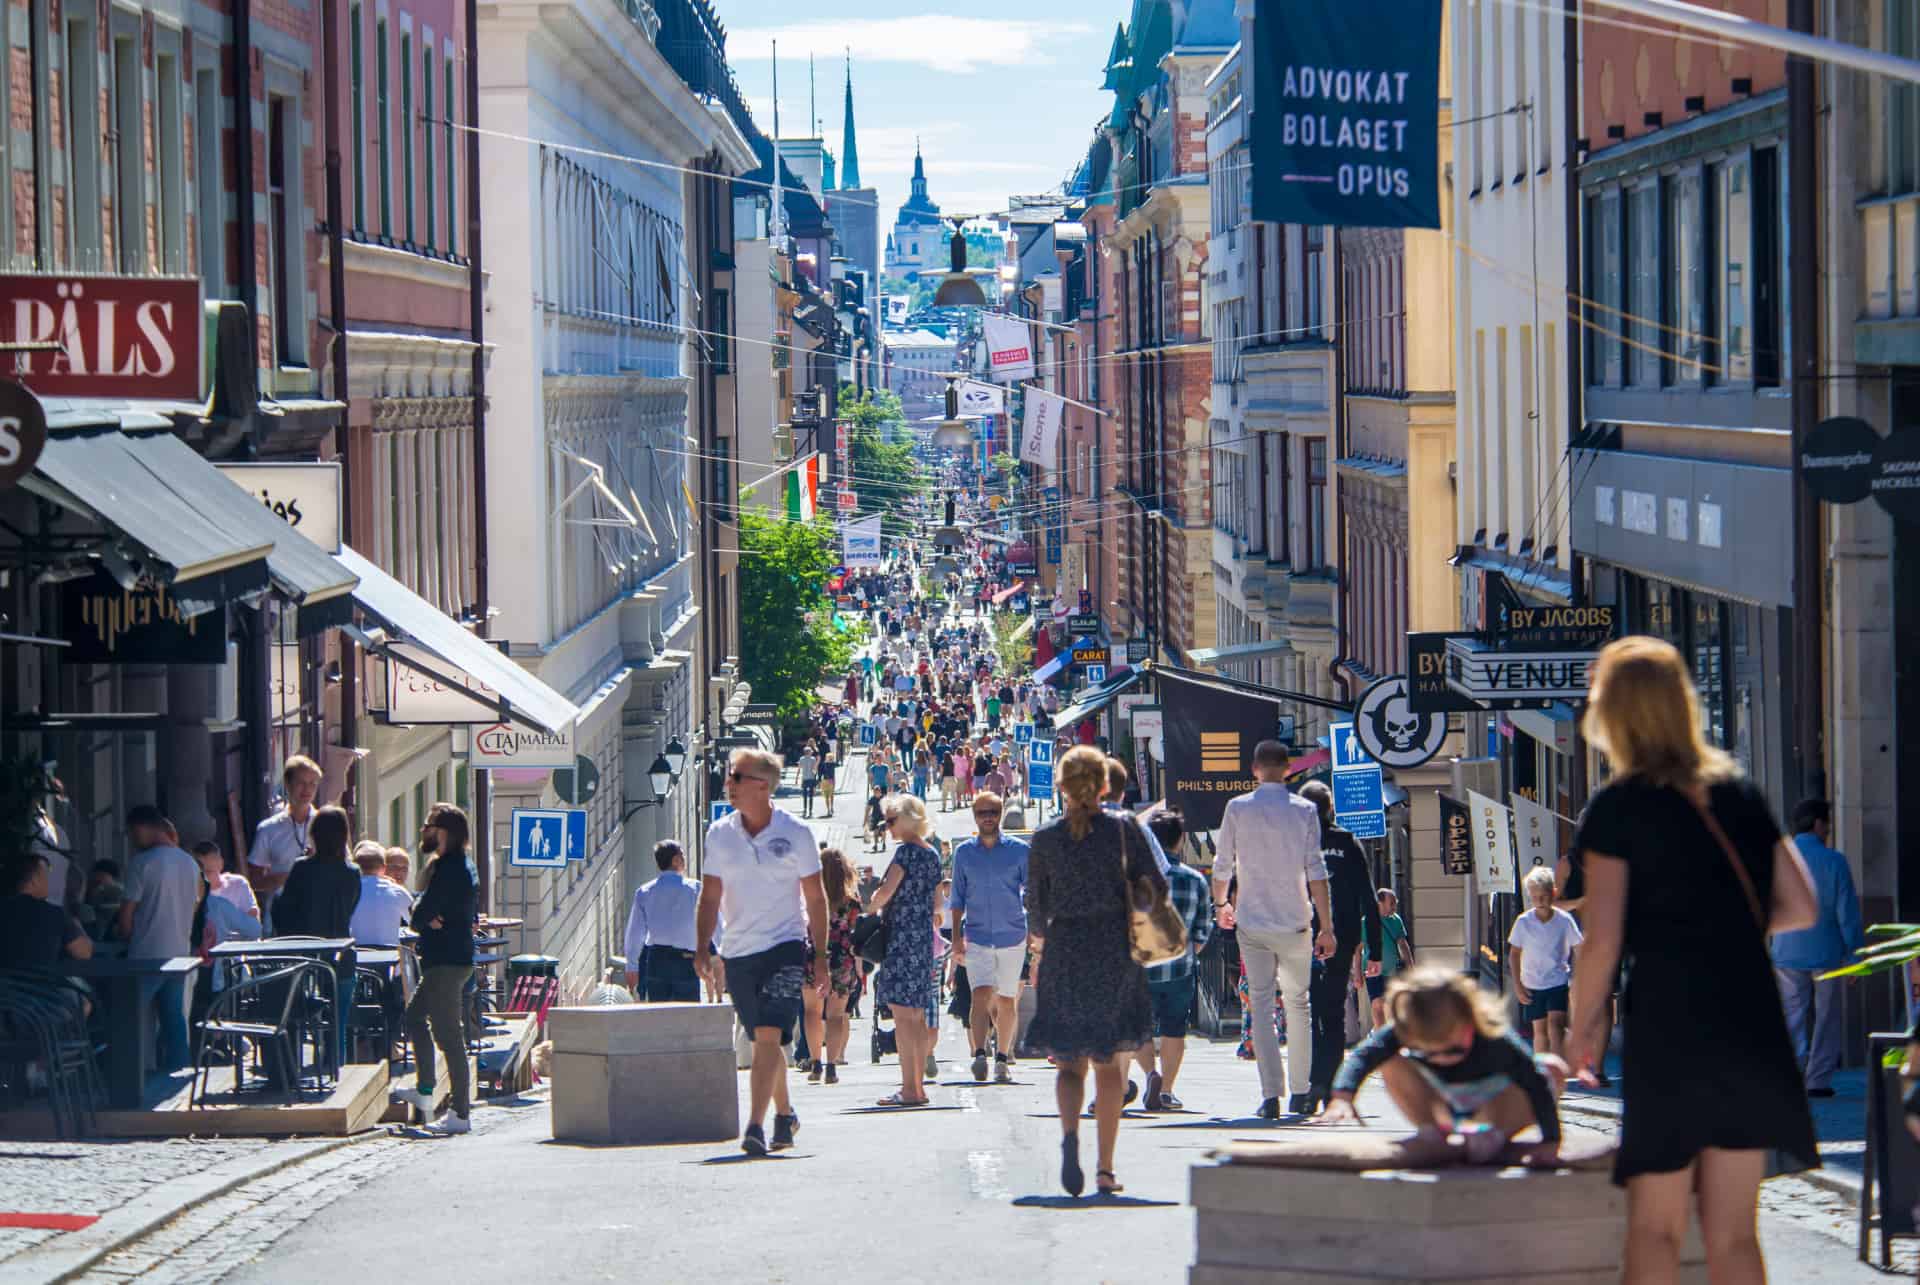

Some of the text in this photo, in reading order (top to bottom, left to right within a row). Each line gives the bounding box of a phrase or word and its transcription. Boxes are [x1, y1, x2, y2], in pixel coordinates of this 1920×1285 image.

[1282, 66, 1409, 104] ADVOKAT
[1282, 113, 1408, 152] BOLAGET
[1338, 164, 1409, 196] OPUS
[9, 283, 175, 377] PÄLS
[1512, 607, 1612, 629] BY JACOBS
[1418, 653, 1447, 675] BY
[1484, 662, 1585, 689] VENUE
[1177, 780, 1260, 791] PHIL'S BURGE
